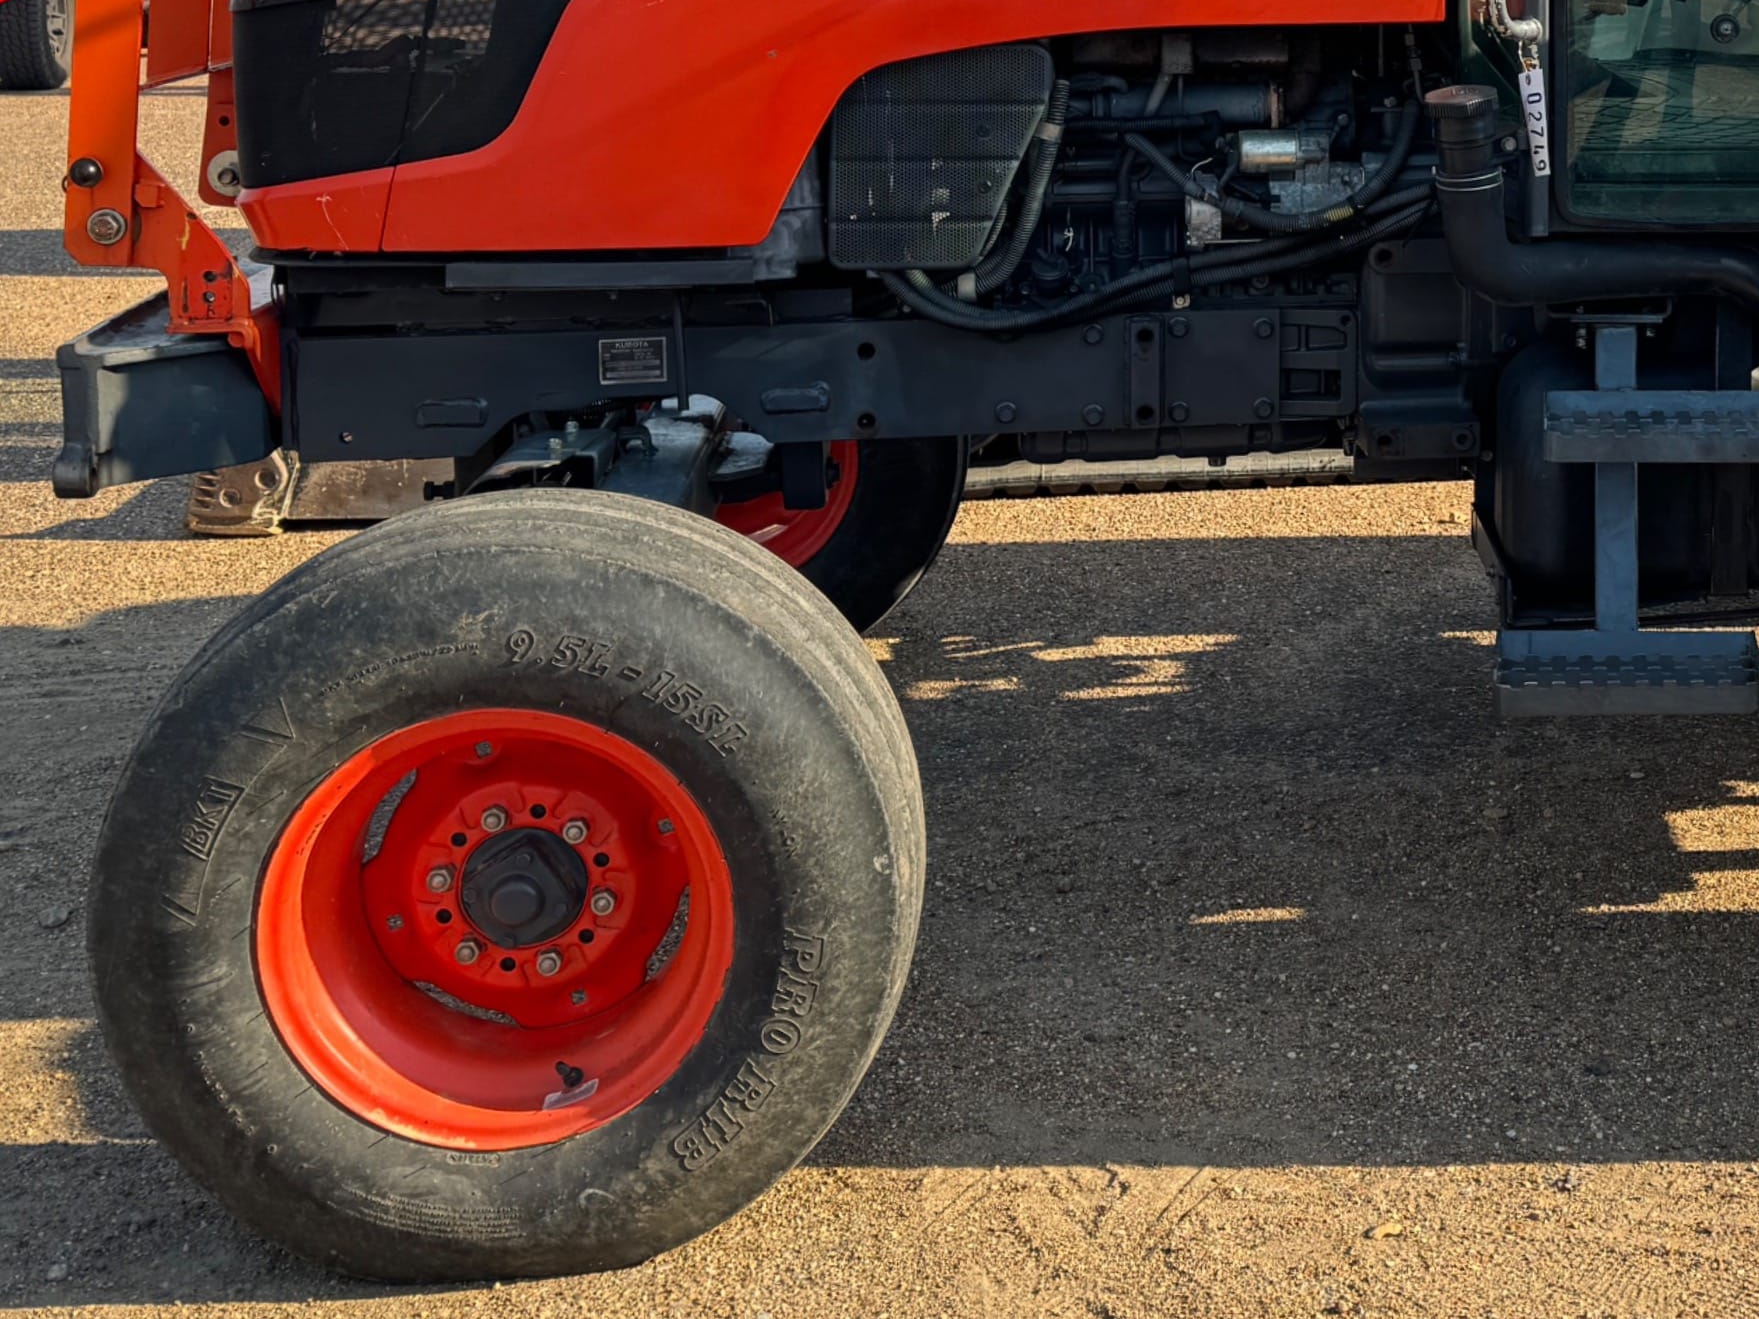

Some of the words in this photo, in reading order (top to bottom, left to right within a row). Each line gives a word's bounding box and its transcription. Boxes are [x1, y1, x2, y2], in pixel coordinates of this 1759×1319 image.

[1527, 92, 1547, 172] 02749
[180, 776, 246, 862] BKT
[760, 927, 825, 1055] PRO
[672, 1057, 777, 1172] RIB
